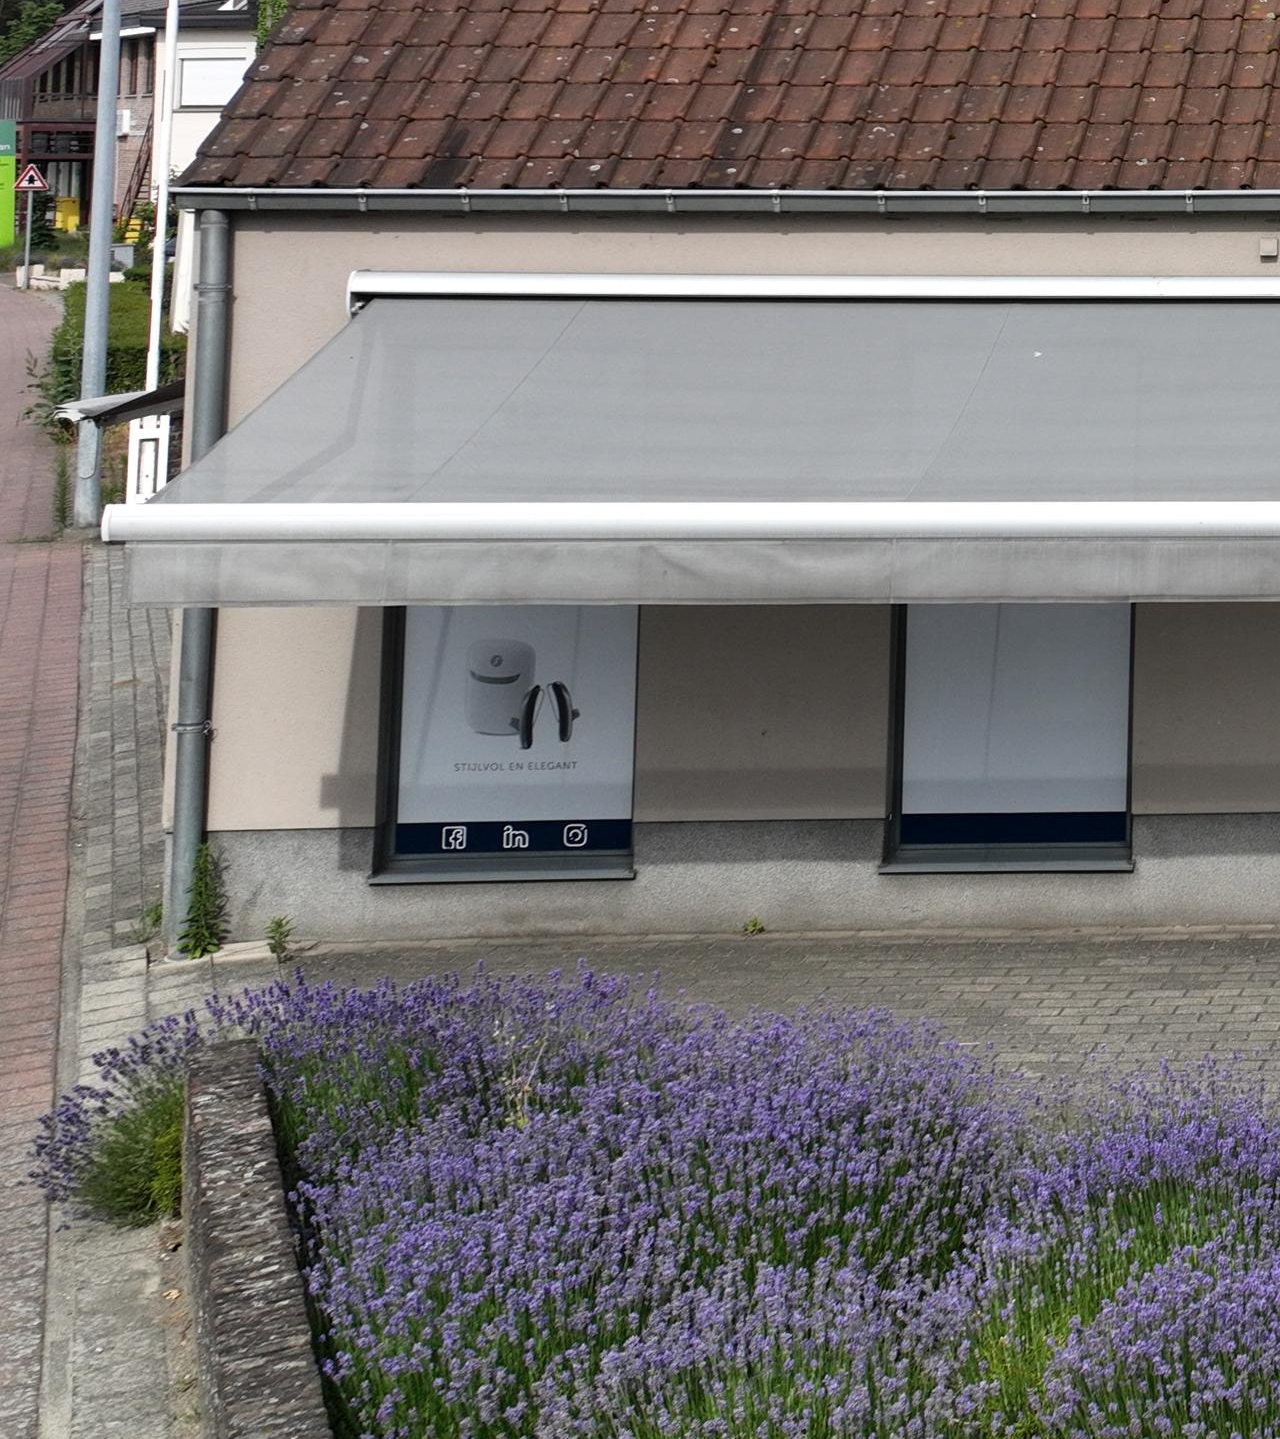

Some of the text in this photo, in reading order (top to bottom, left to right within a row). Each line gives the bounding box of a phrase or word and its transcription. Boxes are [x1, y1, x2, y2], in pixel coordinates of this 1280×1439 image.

[454, 761, 577, 772] STIJLVOL EN ELEGANT
